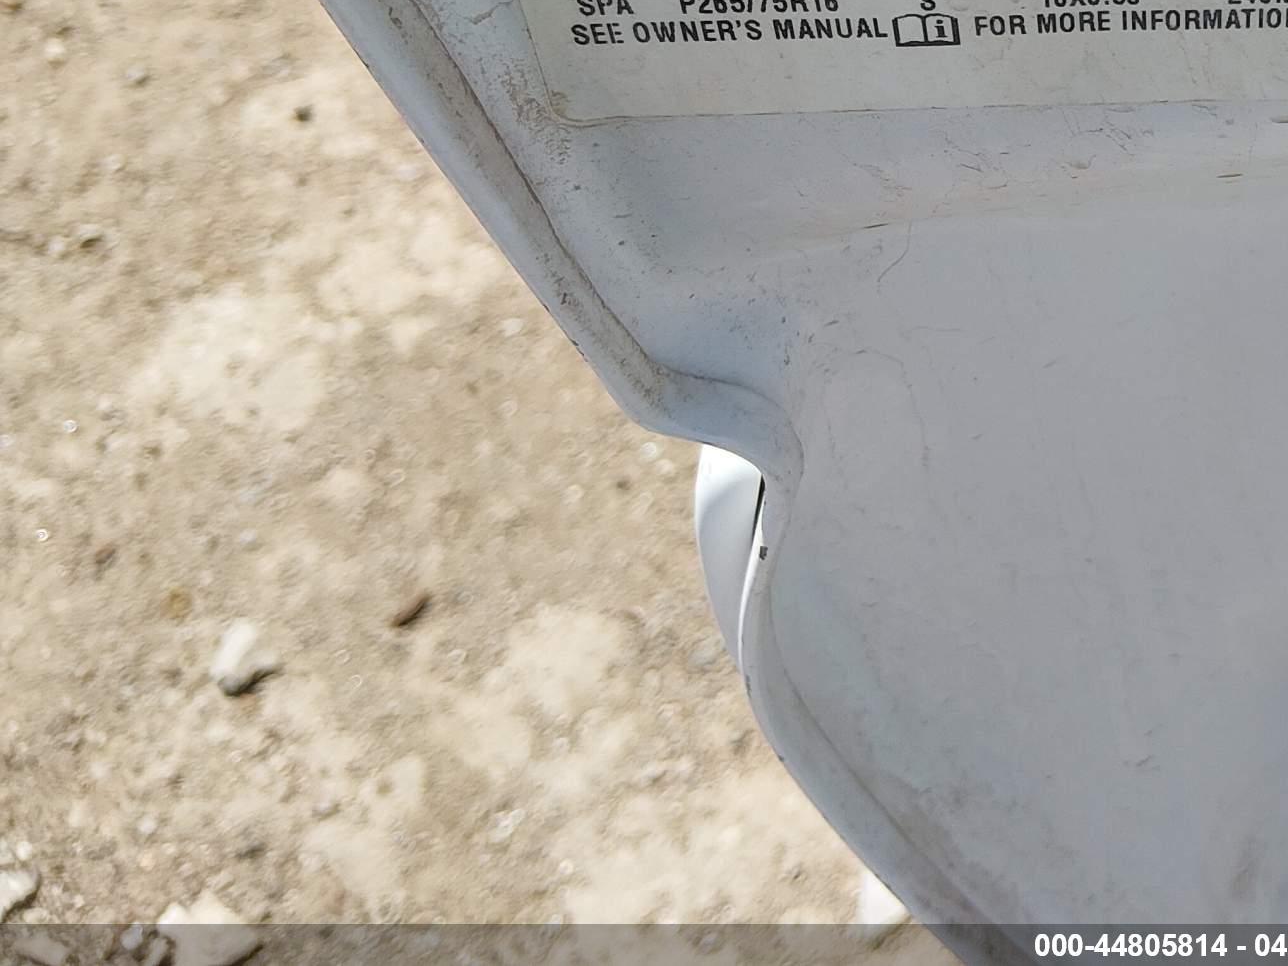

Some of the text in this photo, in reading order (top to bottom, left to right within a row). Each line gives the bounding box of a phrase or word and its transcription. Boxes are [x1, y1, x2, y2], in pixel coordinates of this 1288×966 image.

[571, 23, 625, 47] SEE
[633, 20, 762, 44] OWNER'S
[773, 16, 888, 41] MANUAL
[975, 15, 1026, 34] FOR
[1037, 10, 1110, 33] MORE
